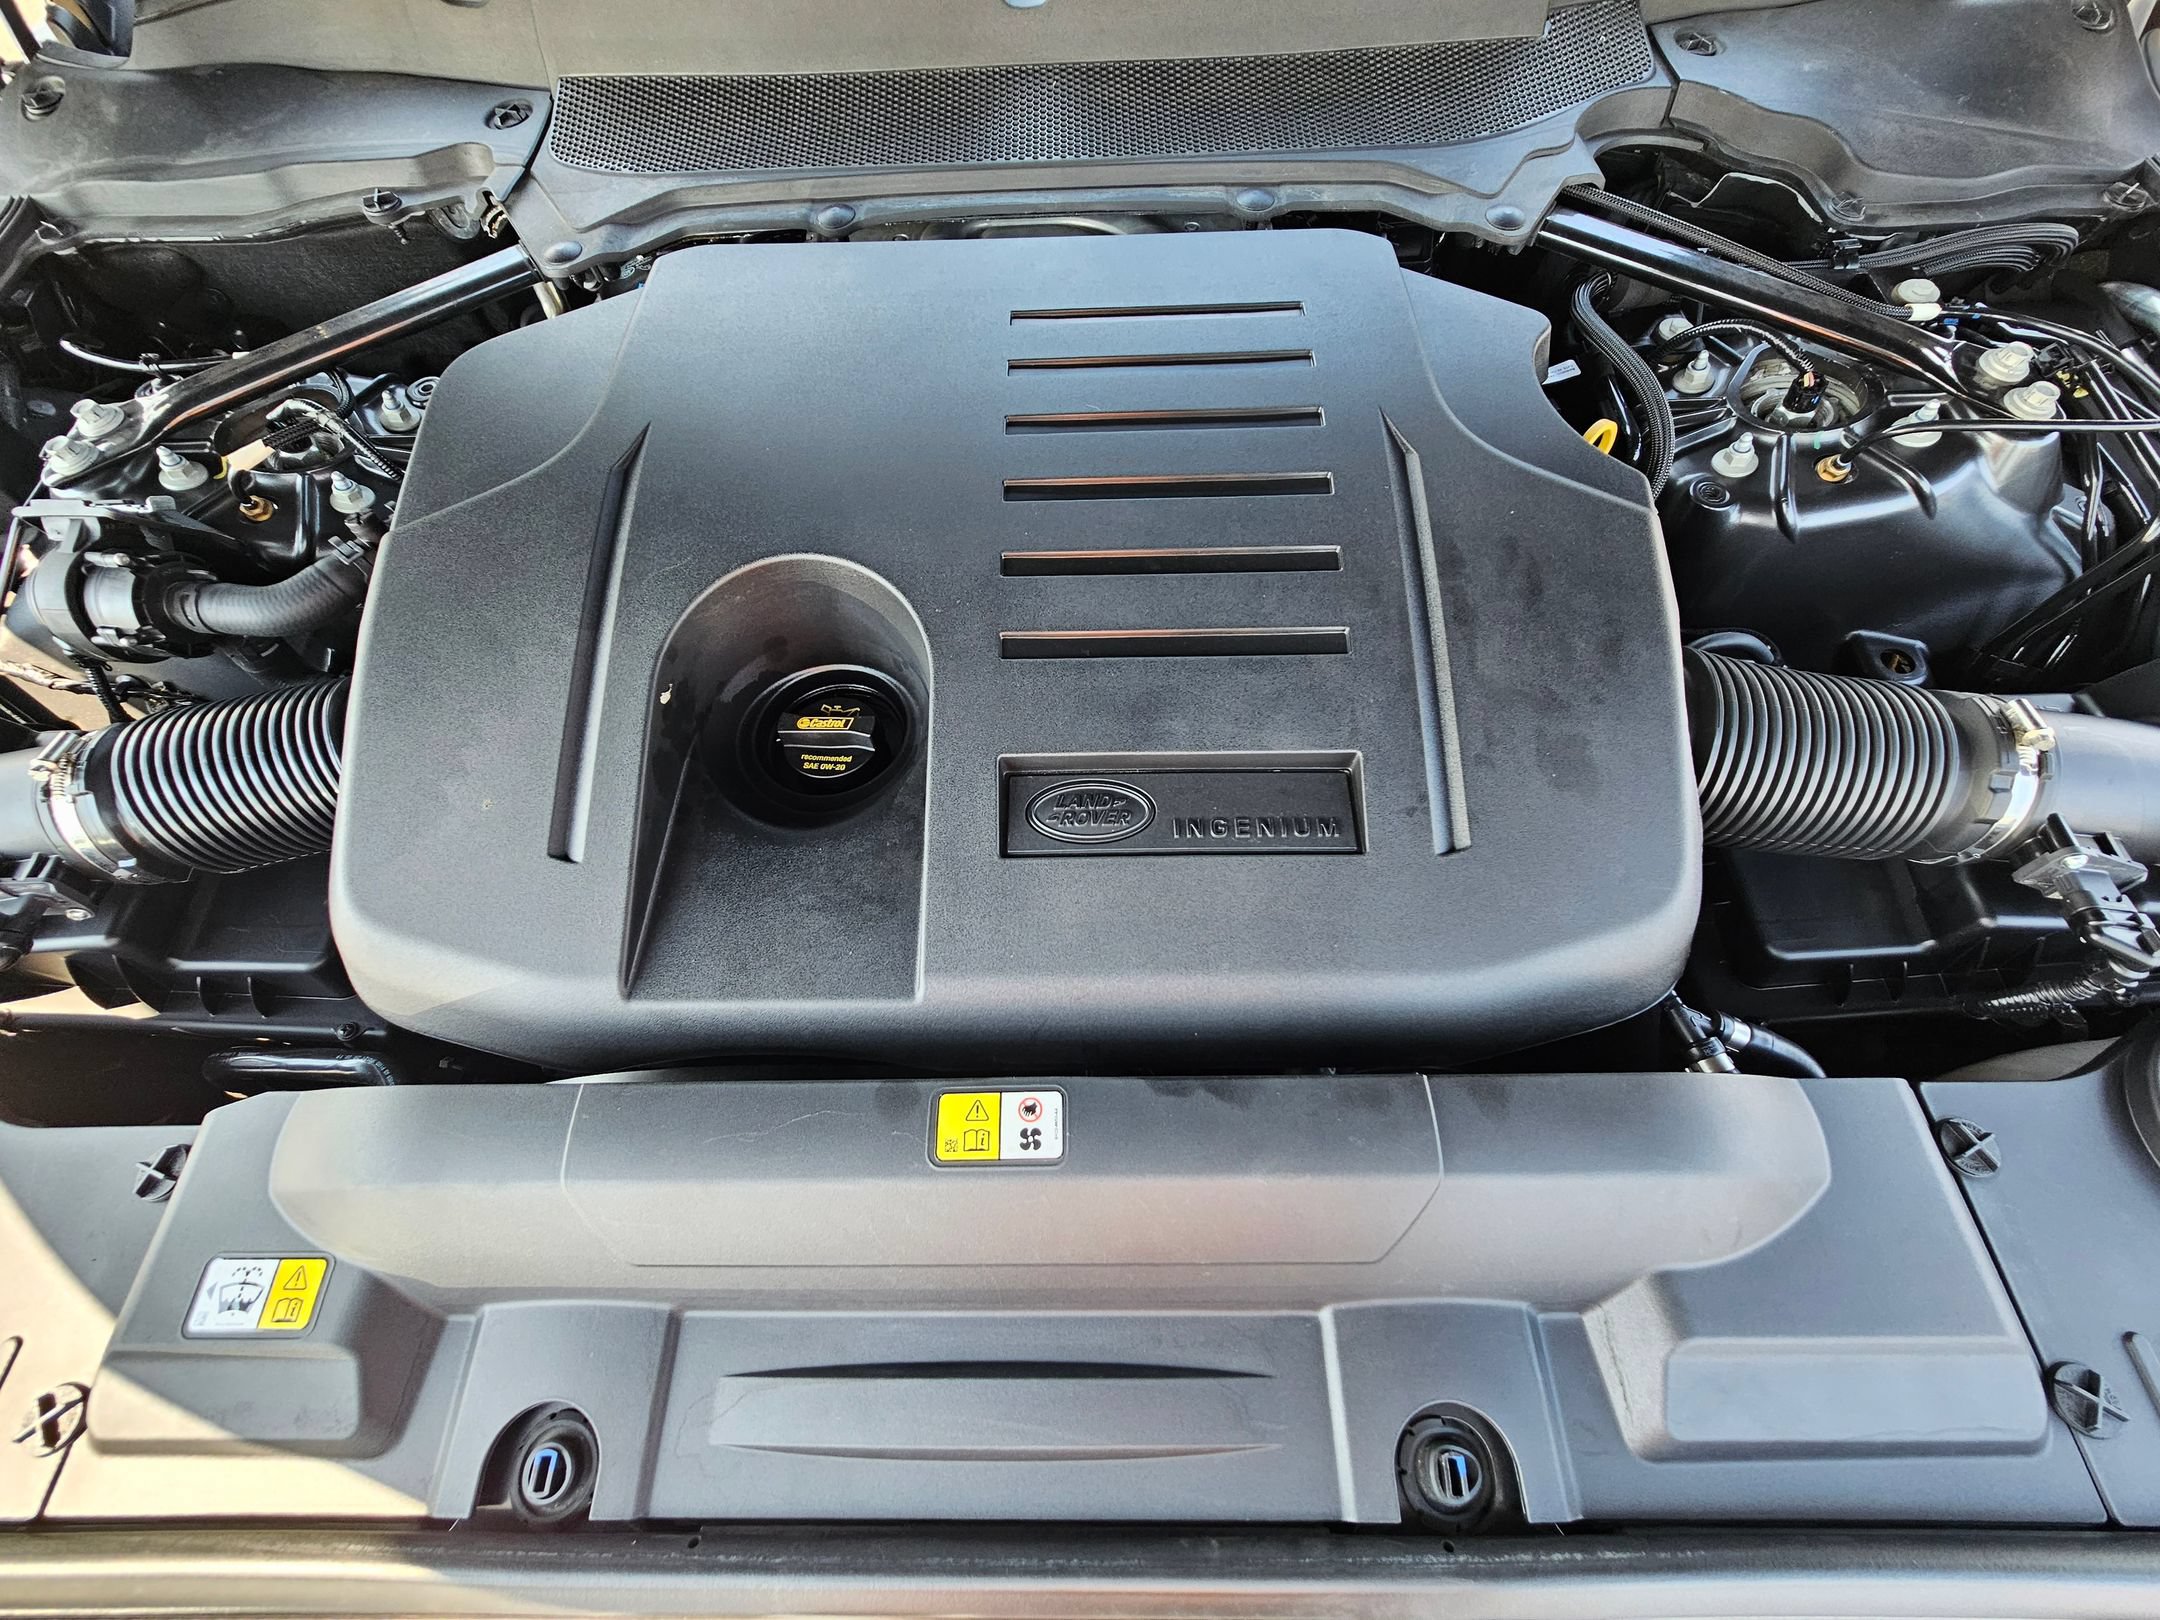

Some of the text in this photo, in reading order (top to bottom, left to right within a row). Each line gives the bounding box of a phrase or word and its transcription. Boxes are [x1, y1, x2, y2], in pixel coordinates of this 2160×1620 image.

[810, 717, 846, 728] Castrol
[801, 753, 853, 763] recommended
[803, 762, 846, 771] SAE 0W-20
[1054, 793, 1112, 810] LAND
[1058, 810, 1132, 826] ROVER
[1172, 817, 1340, 838] INGENIUM
